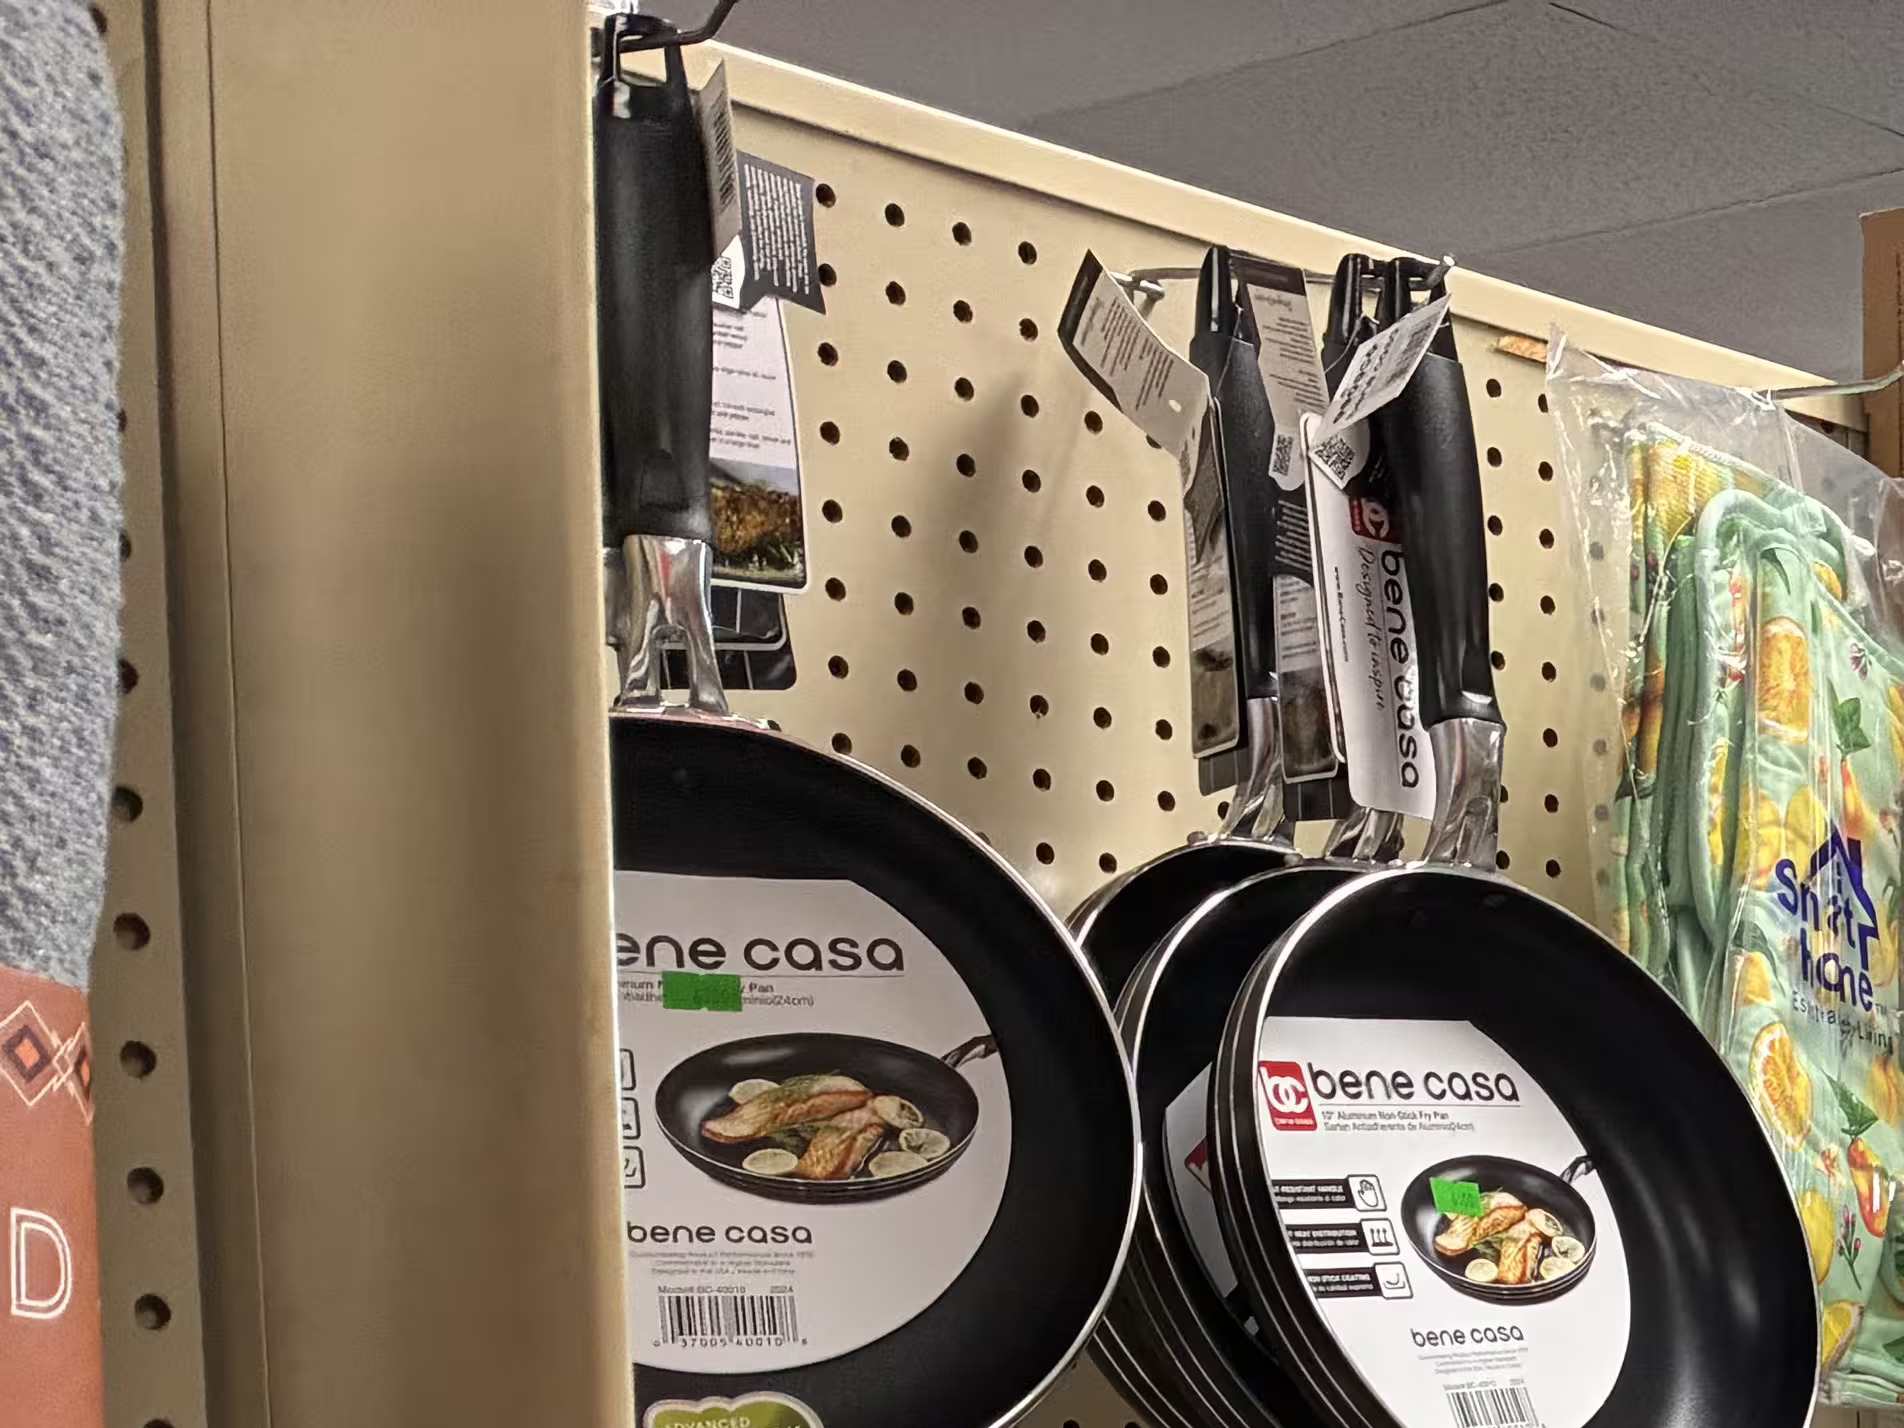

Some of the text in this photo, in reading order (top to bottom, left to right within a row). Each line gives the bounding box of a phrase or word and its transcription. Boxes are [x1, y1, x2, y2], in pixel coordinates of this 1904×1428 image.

[1382, 550, 1420, 789] bene casa
[616, 933, 903, 971] ene casa
[1307, 1062, 1520, 1101] bene casa
[627, 1221, 812, 1244] bene casa
[9, 1207, 73, 1321] D
[1410, 1326, 1524, 1347] bene casa
